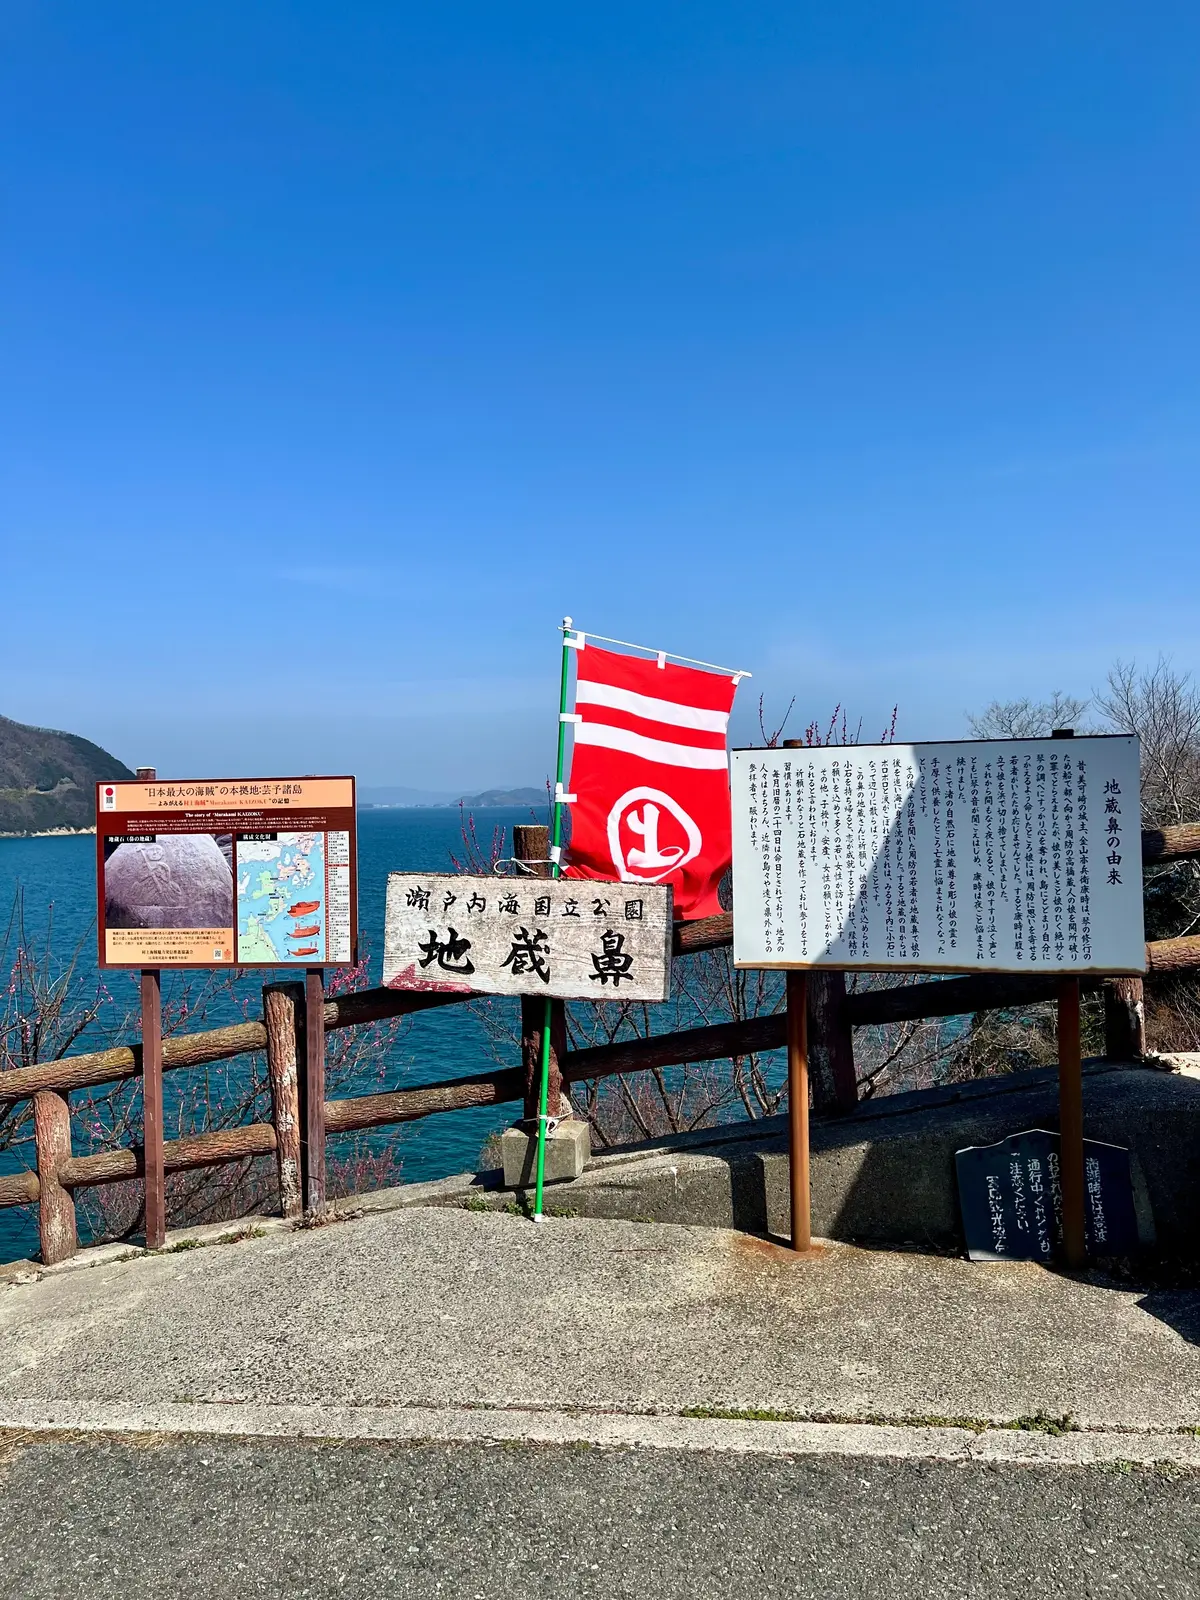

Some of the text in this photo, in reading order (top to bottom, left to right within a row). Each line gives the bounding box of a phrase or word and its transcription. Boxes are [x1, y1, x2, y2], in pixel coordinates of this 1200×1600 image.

[783, 762, 794, 825] 習慣があります。
[919, 758, 928, 818] ということです。
[956, 757, 967, 804] 続けました。
[808, 761, 819, 867] られると言われております。
[1103, 779, 1123, 885] 地蔵鼻の由来
[417, 926, 635, 988] 地蔵鼻
